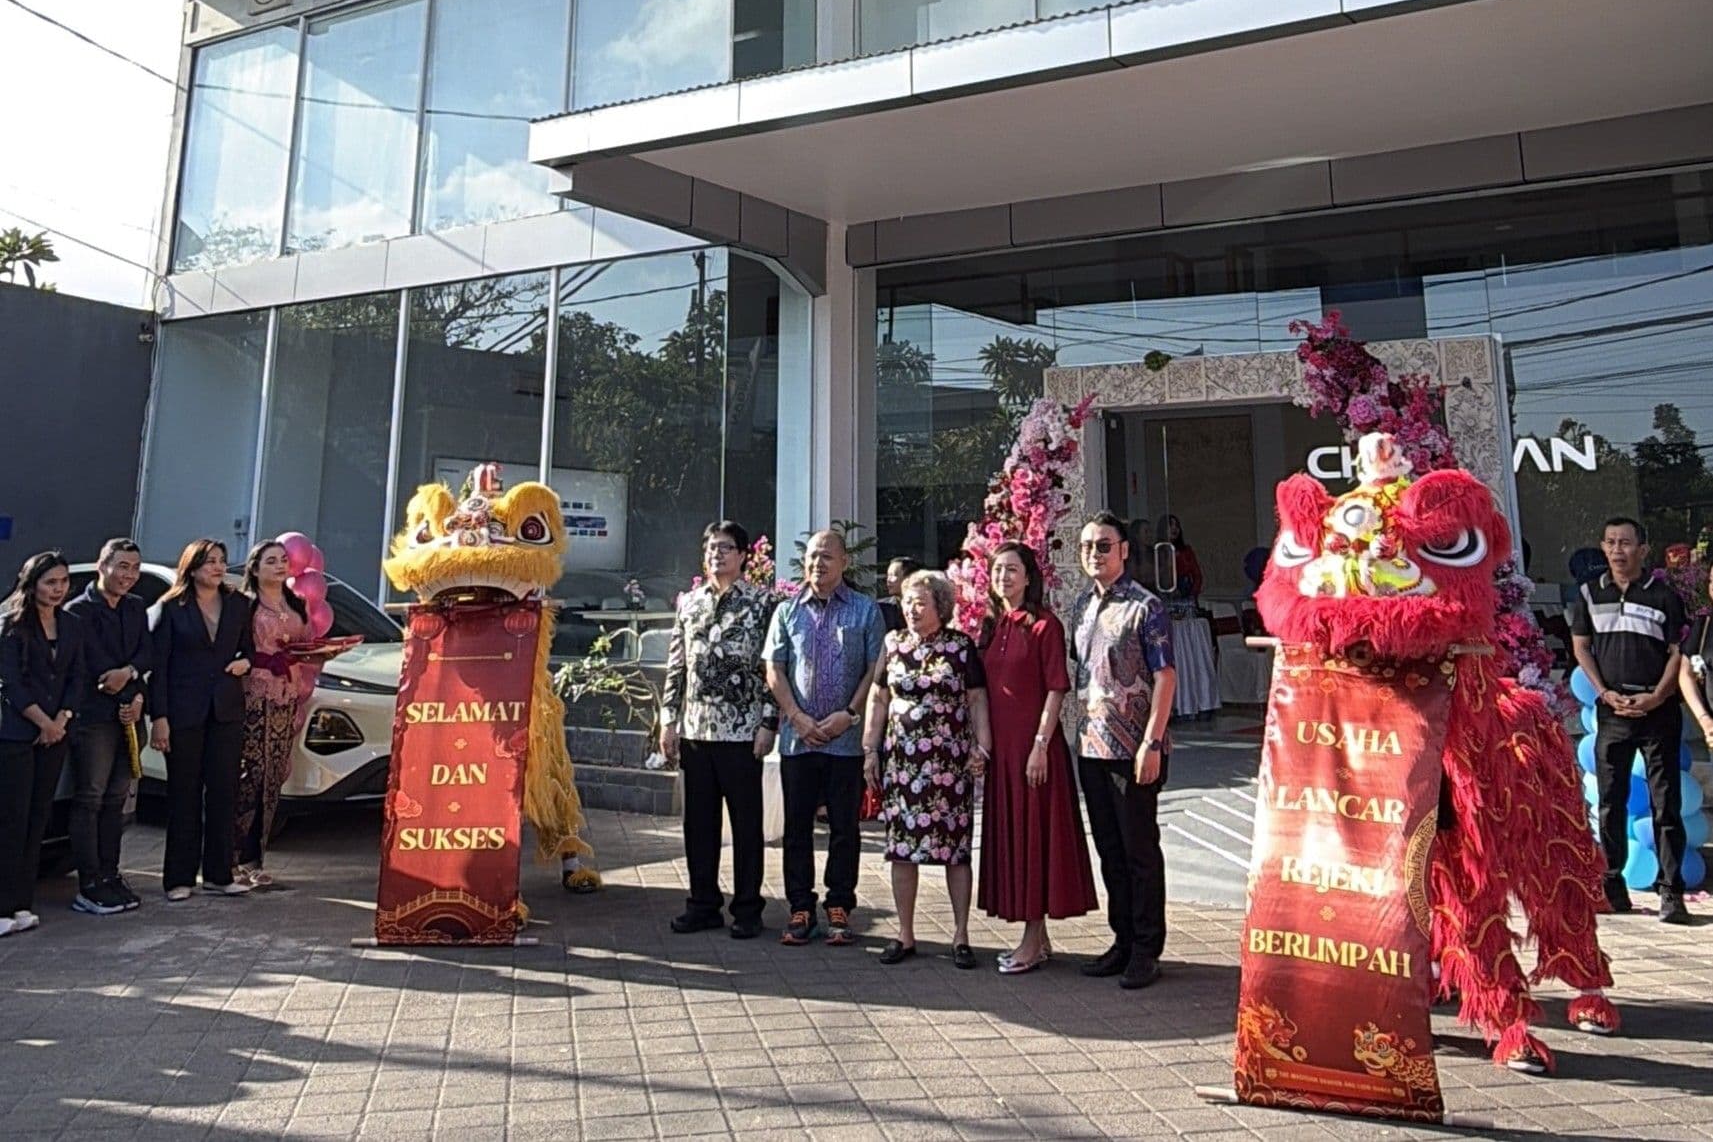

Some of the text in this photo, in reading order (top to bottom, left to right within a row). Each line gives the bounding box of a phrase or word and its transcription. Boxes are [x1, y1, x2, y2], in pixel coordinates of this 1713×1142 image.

[405, 701, 526, 724] SELAMAT
[1296, 720, 1403, 756] USAHA
[431, 762, 488, 786] DAN
[1275, 784, 1405, 825] LANCAR
[399, 826, 506, 851] SUKSES
[1280, 856, 1389, 897] REJEKI
[1249, 927, 1412, 979] BERLIMPAH
